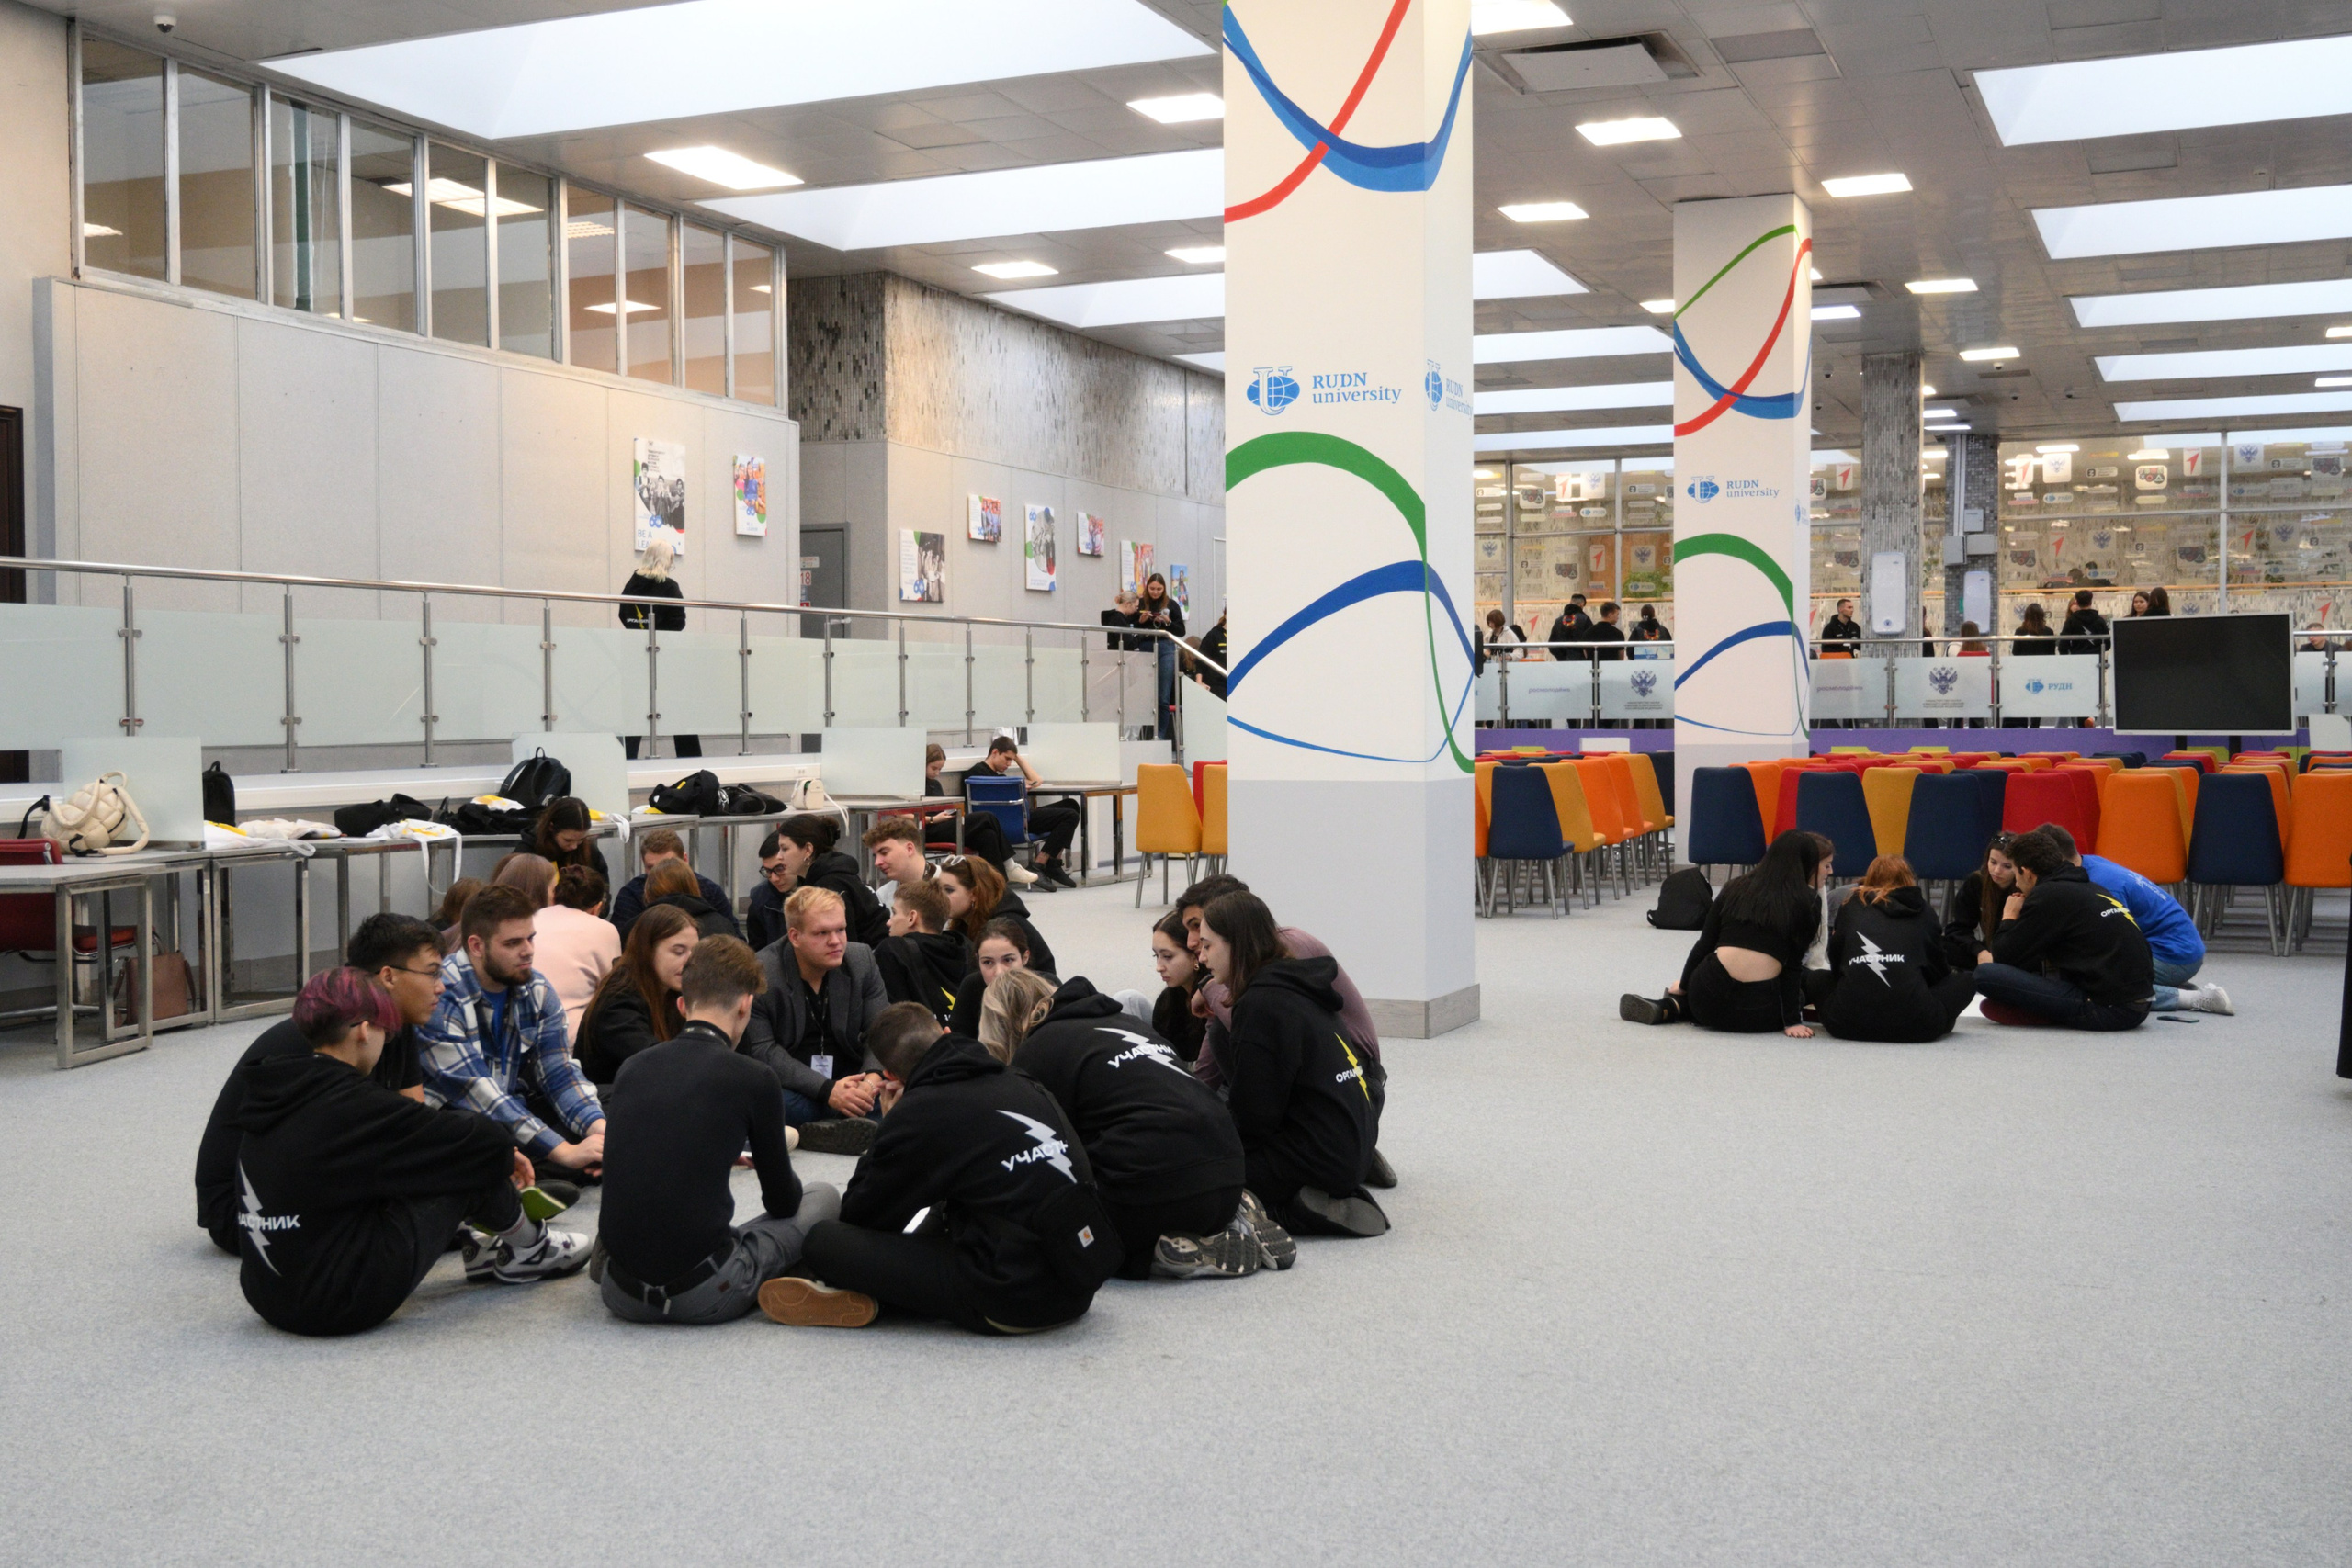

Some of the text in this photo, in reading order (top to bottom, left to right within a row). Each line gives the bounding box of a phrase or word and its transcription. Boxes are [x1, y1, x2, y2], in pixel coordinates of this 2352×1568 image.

[1312, 372, 1368, 389] RUDN
[1445, 378, 1464, 398] RUDN
[1312, 386, 1402, 404] university
[1446, 397, 1473, 420] university
[1726, 479, 1759, 490] RUDN
[1726, 487, 1780, 499] university
[649, 514, 663, 528] 60
[638, 528, 653, 538] BE A
[913, 579, 925, 595] 60
[2048, 682, 2073, 692] РУДН
[1848, 953, 1905, 966] УЧАСТНИК
[1107, 1043, 1177, 1068] УЧАСТНИ
